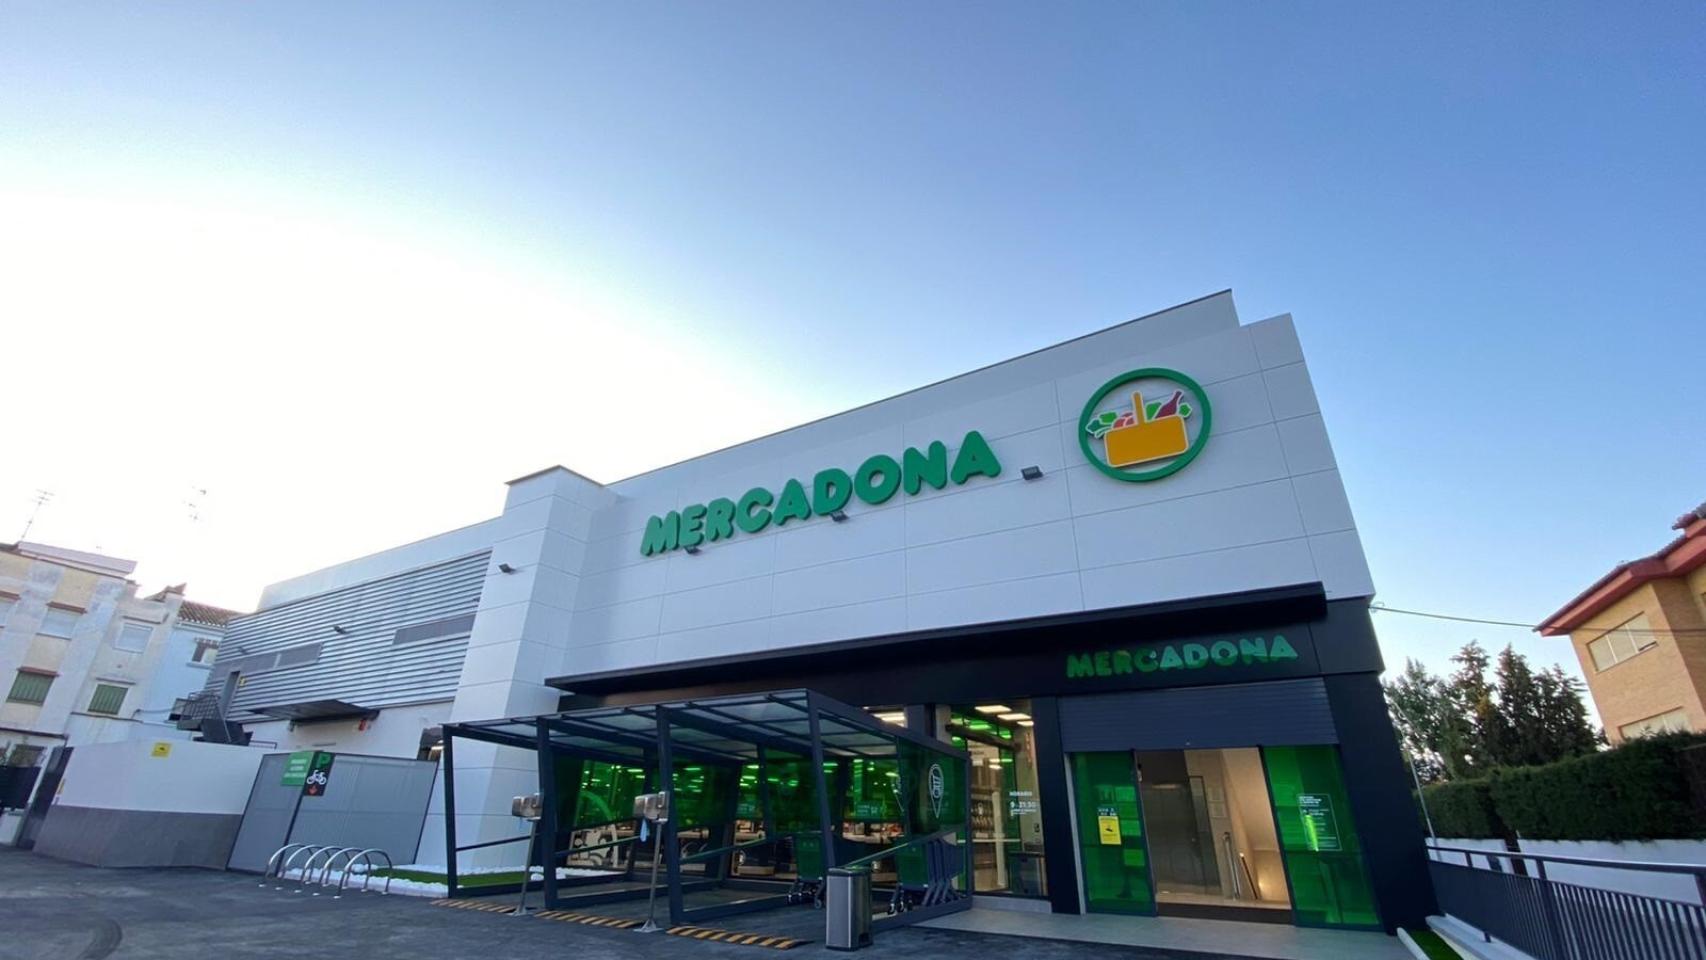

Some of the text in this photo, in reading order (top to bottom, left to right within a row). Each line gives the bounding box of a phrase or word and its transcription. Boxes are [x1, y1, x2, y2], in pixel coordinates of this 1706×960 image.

[640, 430, 1001, 556] MERCADONA
[1066, 634, 1299, 678] MERCADONA
[316, 752, 332, 769] P
